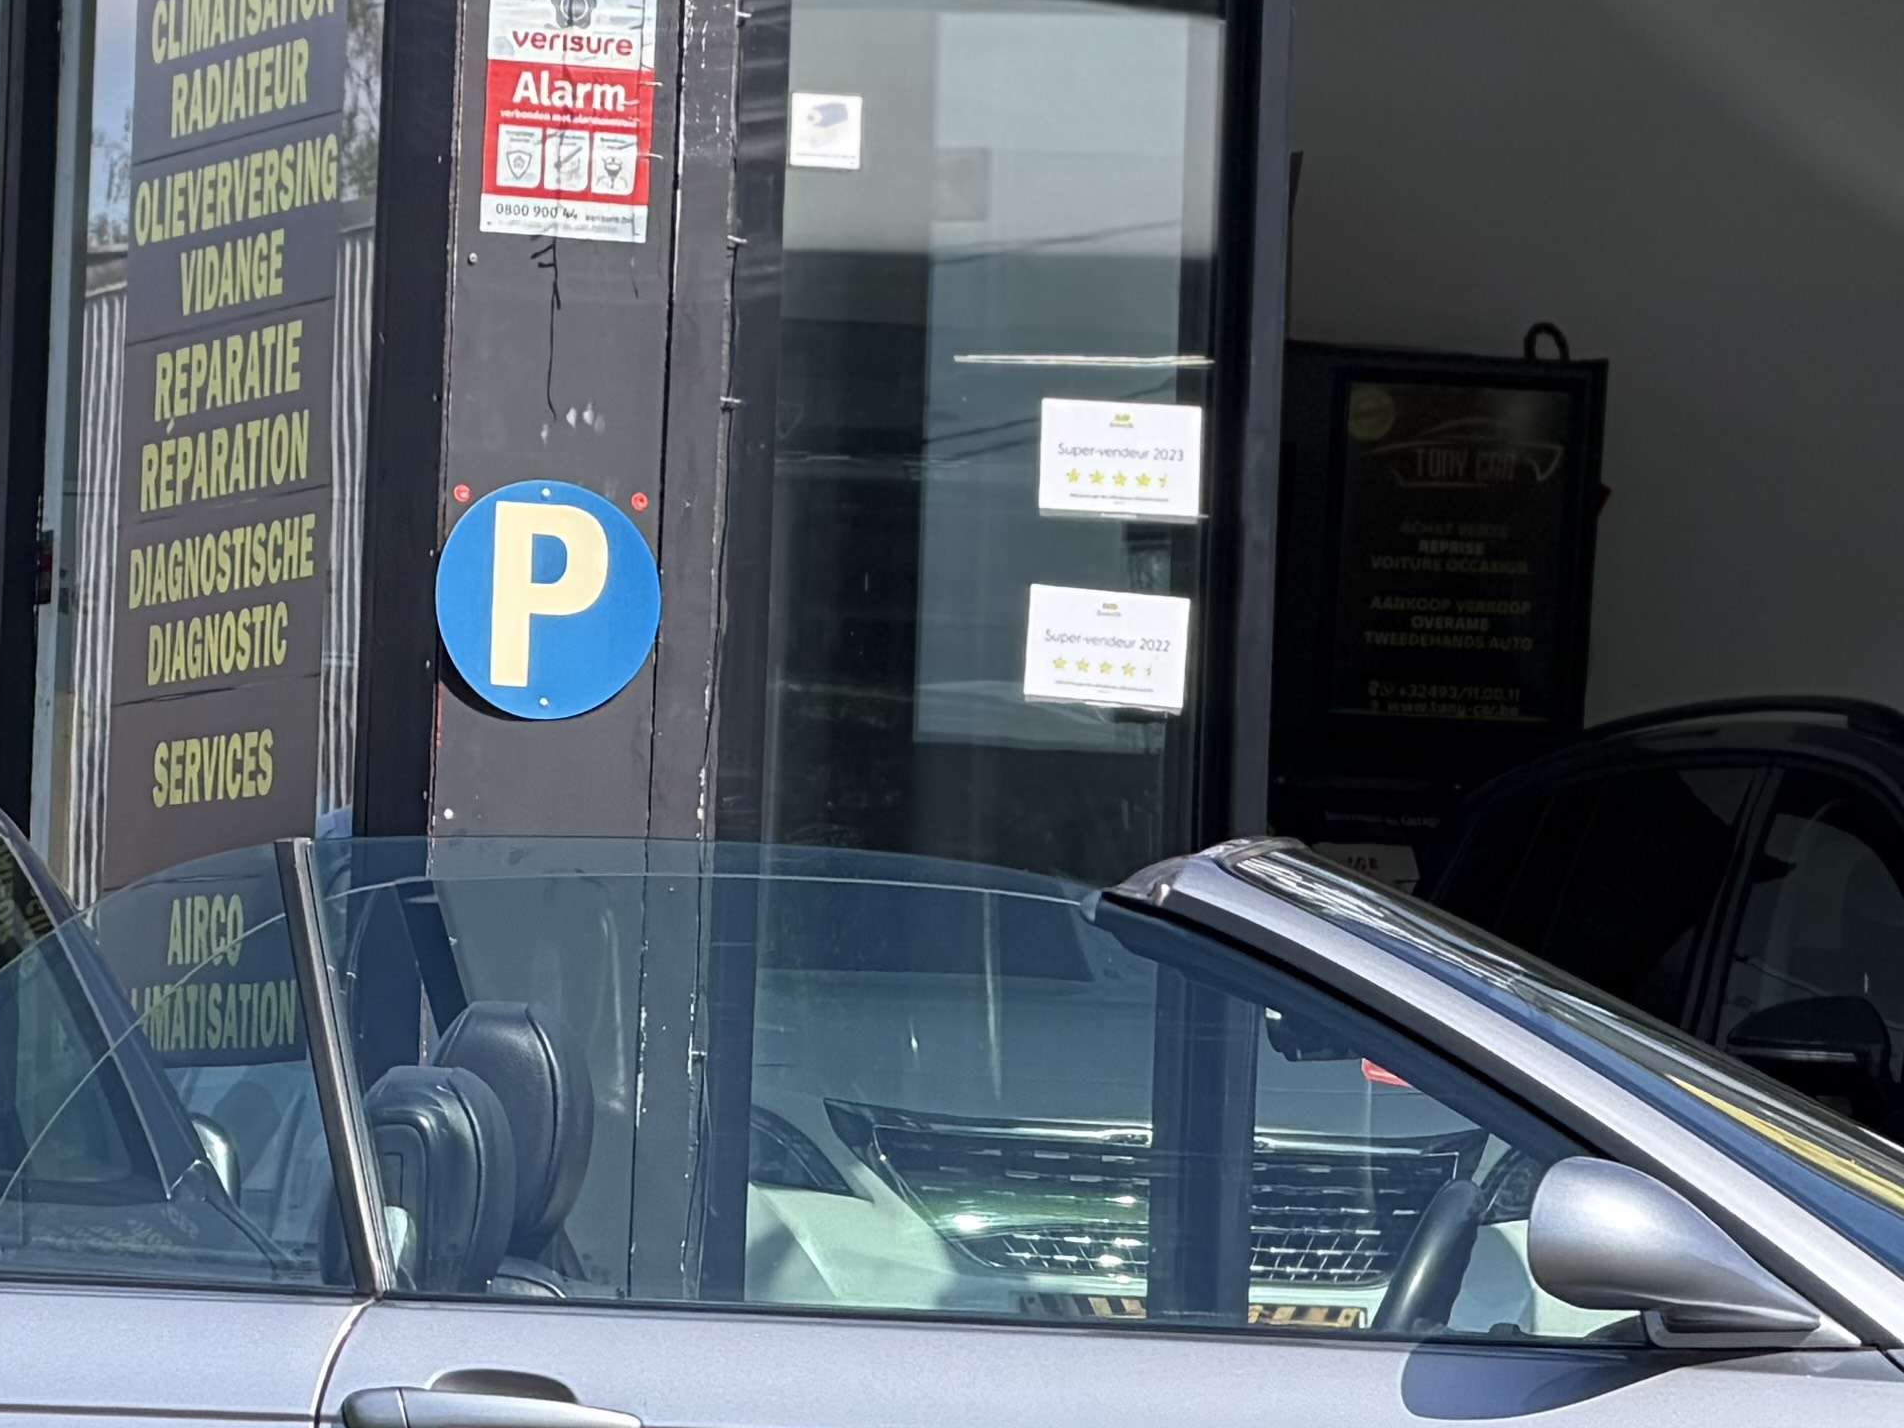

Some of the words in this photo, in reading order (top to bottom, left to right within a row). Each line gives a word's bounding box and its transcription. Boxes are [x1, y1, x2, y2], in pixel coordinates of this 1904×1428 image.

[511, 29, 634, 57] verisure
[170, 39, 310, 139] RADIATEUR
[512, 70, 628, 112] Alarm
[134, 133, 338, 247] OLIEVERVERSING
[496, 203, 530, 218] 0800
[179, 228, 285, 317] VIDANGE
[153, 320, 303, 422] REPARATIE
[1057, 442, 1150, 460] Super-vendeur
[1153, 447, 1184, 462] 2023
[128, 513, 317, 610] DIAGNOSTISCHE
[490, 500, 609, 688] P
[146, 601, 289, 686] DIAGNOSTIC
[1139, 637, 1171, 653] 2022
[152, 728, 274, 808] SERVICES
[167, 893, 244, 967] AIRCO
